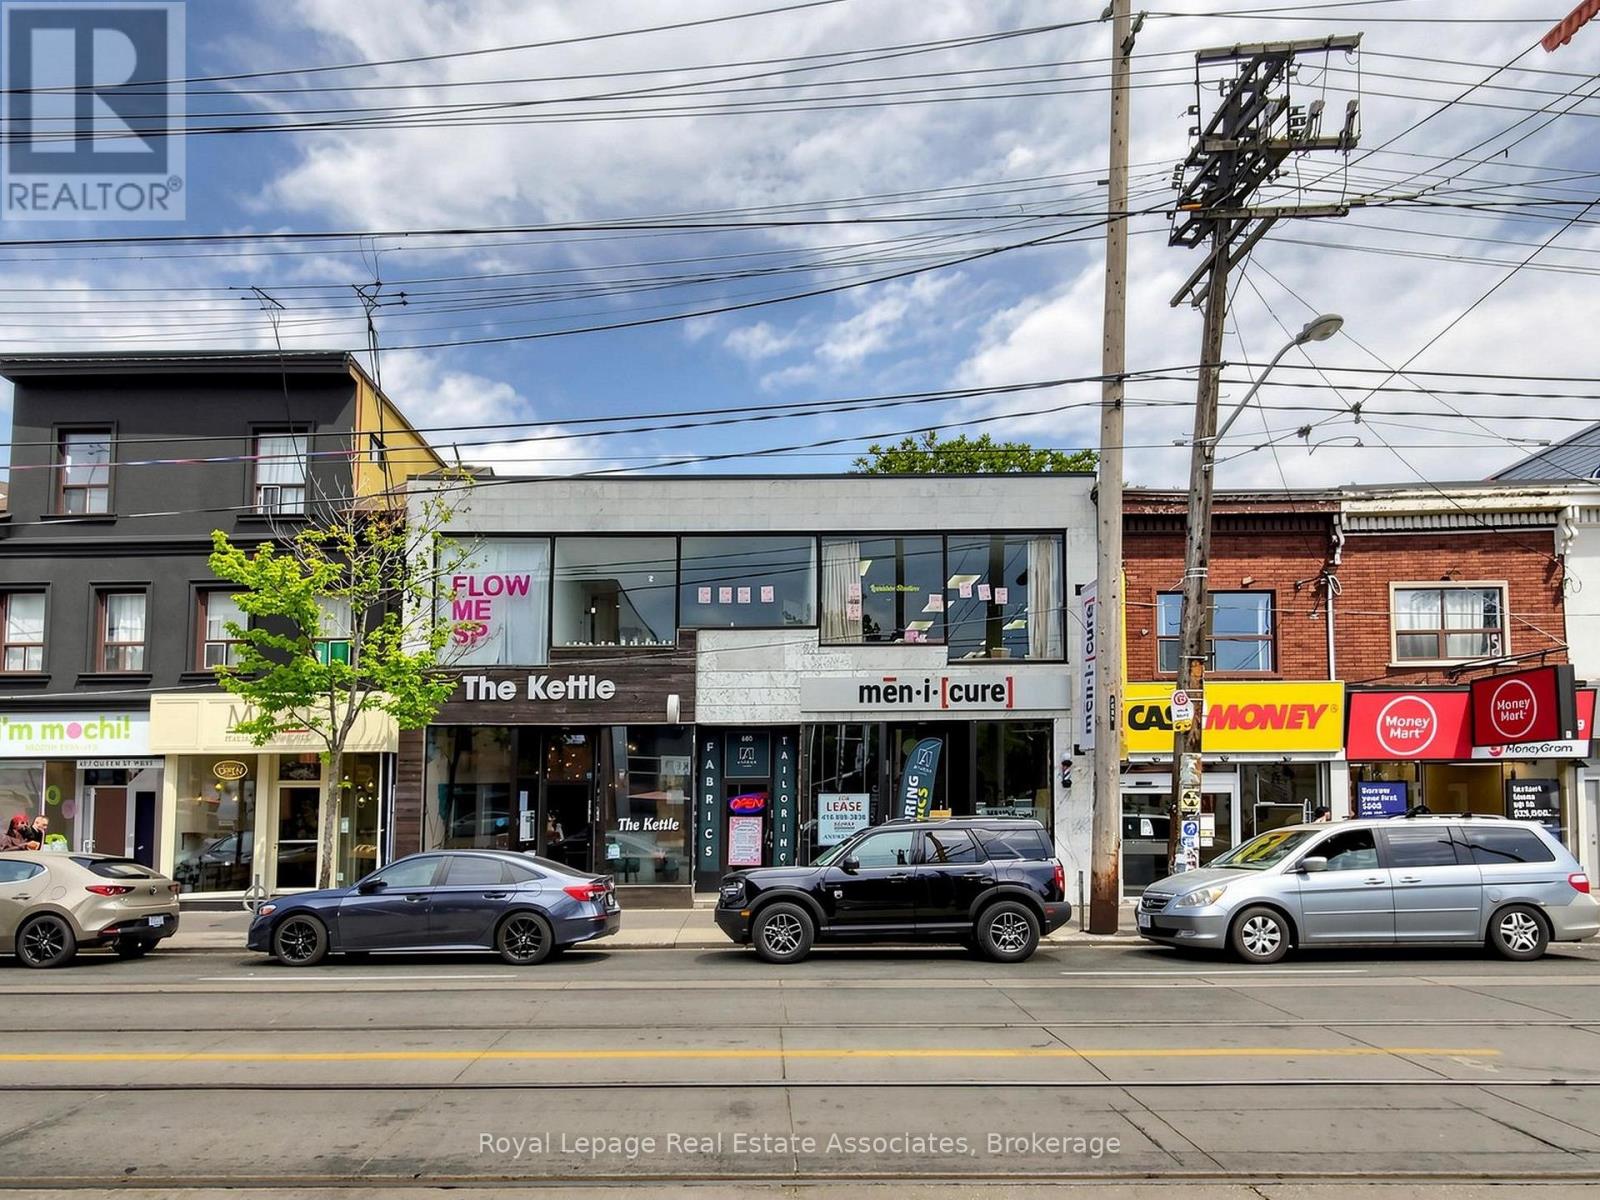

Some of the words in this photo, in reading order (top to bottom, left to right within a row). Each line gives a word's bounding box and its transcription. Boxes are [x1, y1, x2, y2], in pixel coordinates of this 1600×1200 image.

[452, 574, 530, 596] FLOW
[452, 599, 491, 621] ME
[462, 675, 517, 701] The
[527, 675, 617, 701] Kettle
[1496, 698, 1531, 712] Money
[1385, 715, 1431, 729] Money
[1500, 709, 1528, 722] Mart
[1389, 727, 1425, 739] Mart
[1504, 743, 1574, 756] MoneyGram
[704, 742, 715, 857] FABRICS
[826, 801, 863, 812] LEASE
[617, 817, 640, 831] The
[642, 817, 680, 831] Kettle
